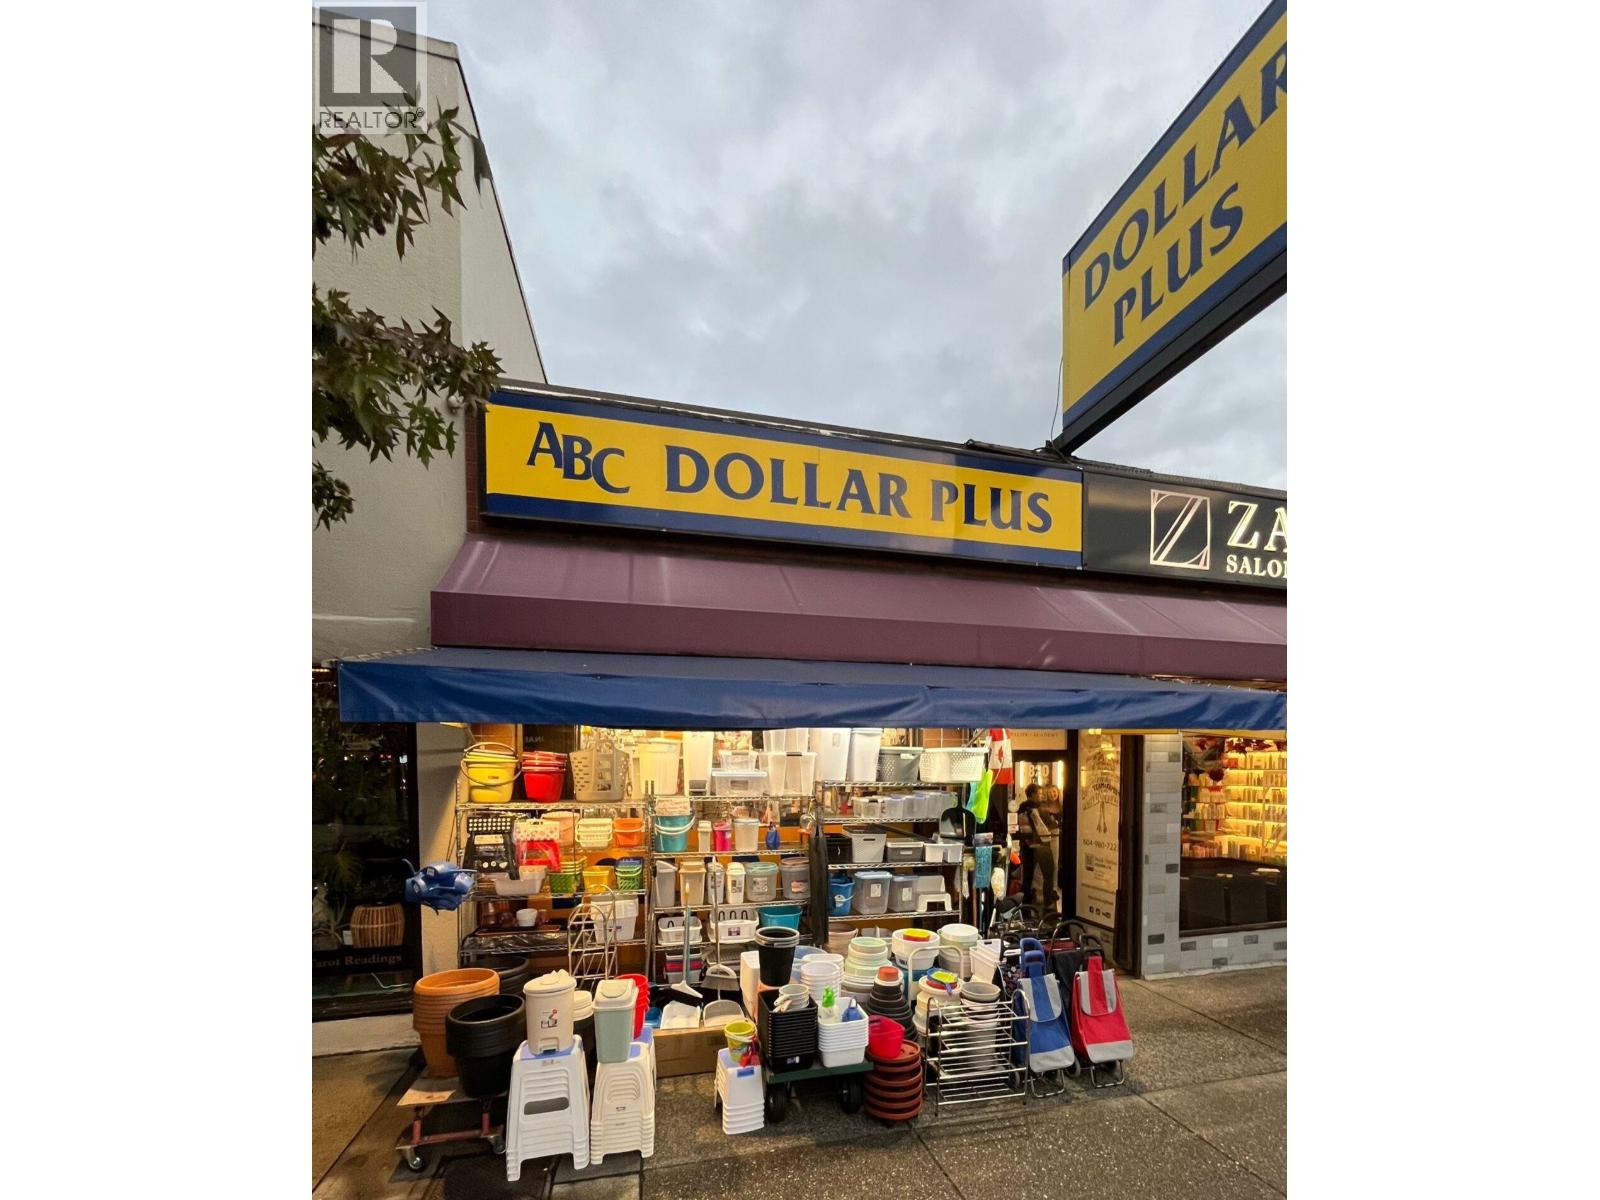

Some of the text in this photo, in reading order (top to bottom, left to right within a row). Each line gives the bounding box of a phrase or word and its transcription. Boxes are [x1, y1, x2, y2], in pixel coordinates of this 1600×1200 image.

[1112, 181, 1244, 347] PLUS
[526, 421, 1053, 534] ABC DOLLAR PLUS
[1226, 554, 1287, 579] SALO
[344, 953, 402, 966] Readings
